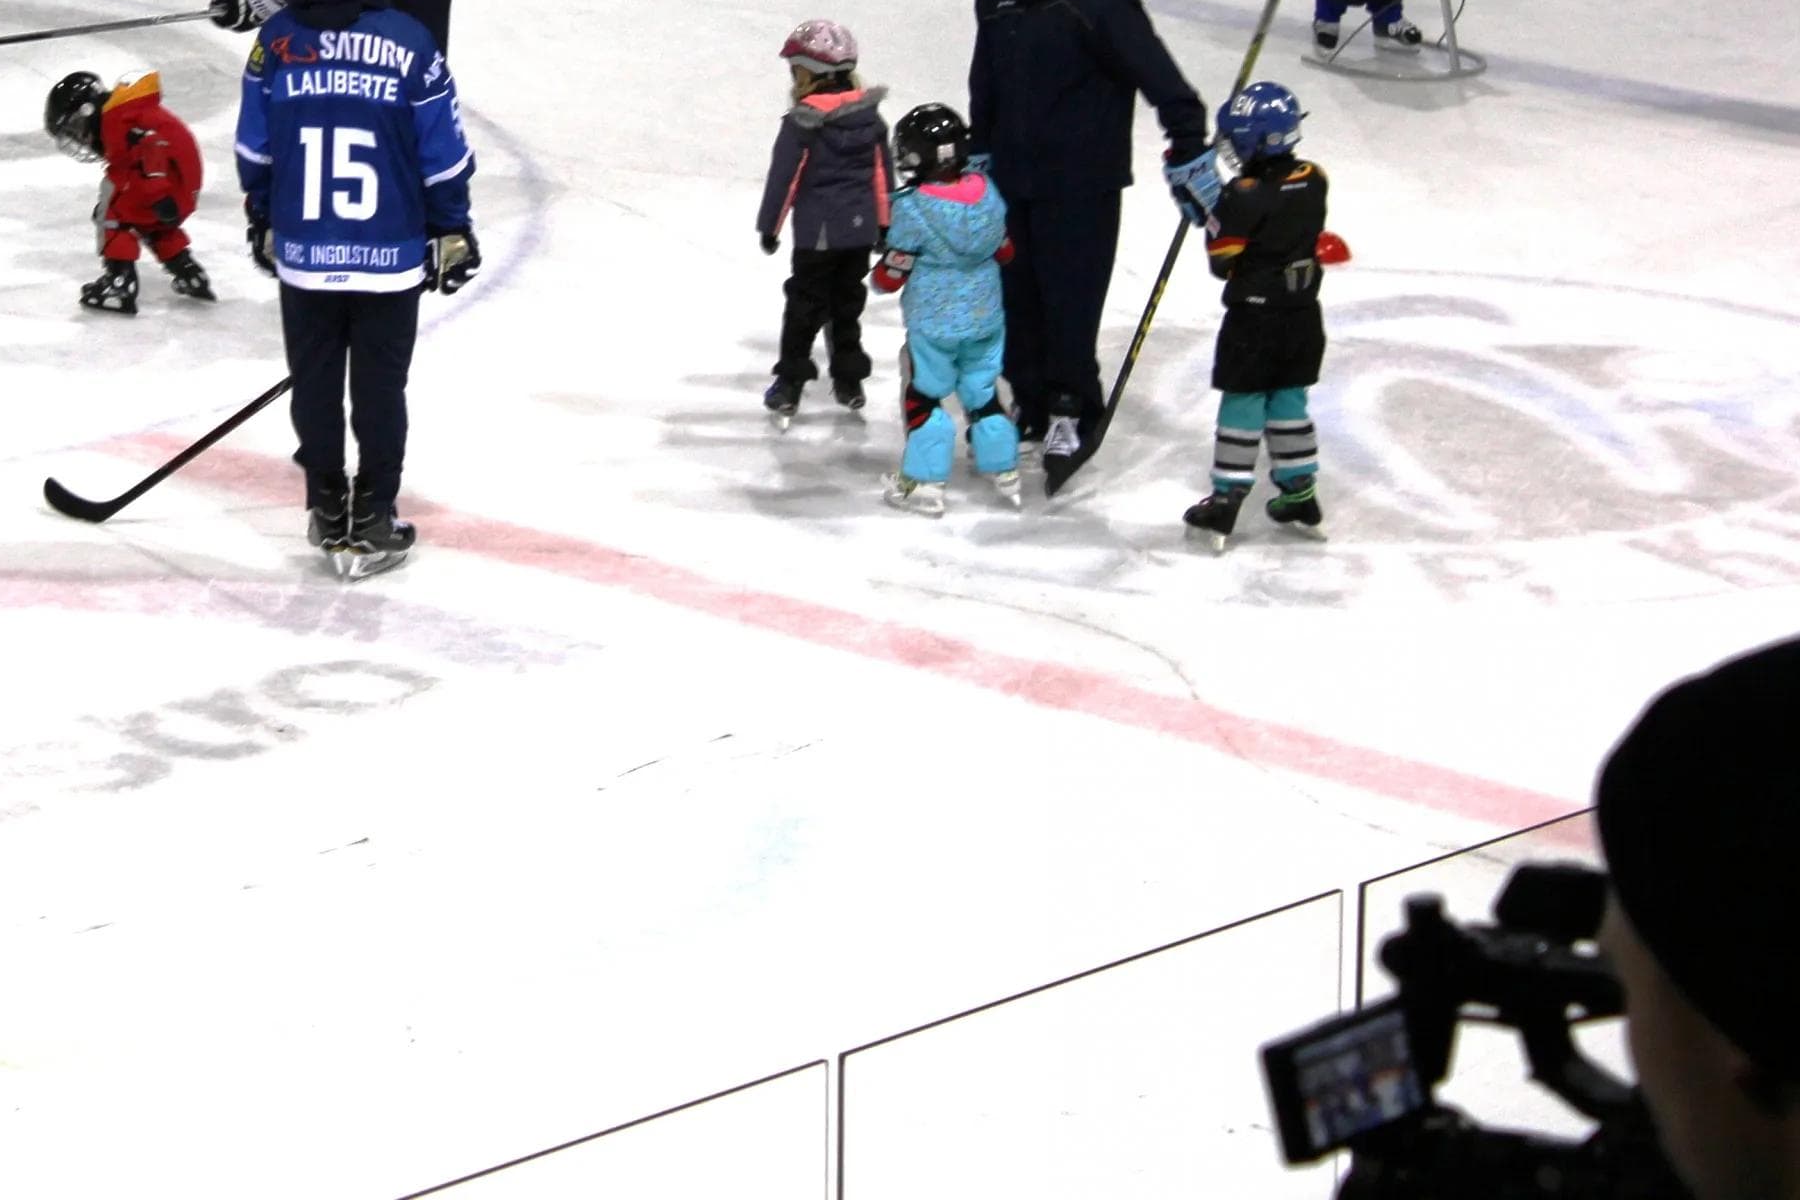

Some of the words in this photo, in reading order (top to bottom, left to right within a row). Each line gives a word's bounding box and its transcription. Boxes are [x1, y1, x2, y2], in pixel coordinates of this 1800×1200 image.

[319, 30, 416, 78] SATURN
[285, 69, 399, 102] LALIBERTE
[299, 126, 379, 222] 15
[310, 243, 400, 267] INGOLSTADT
